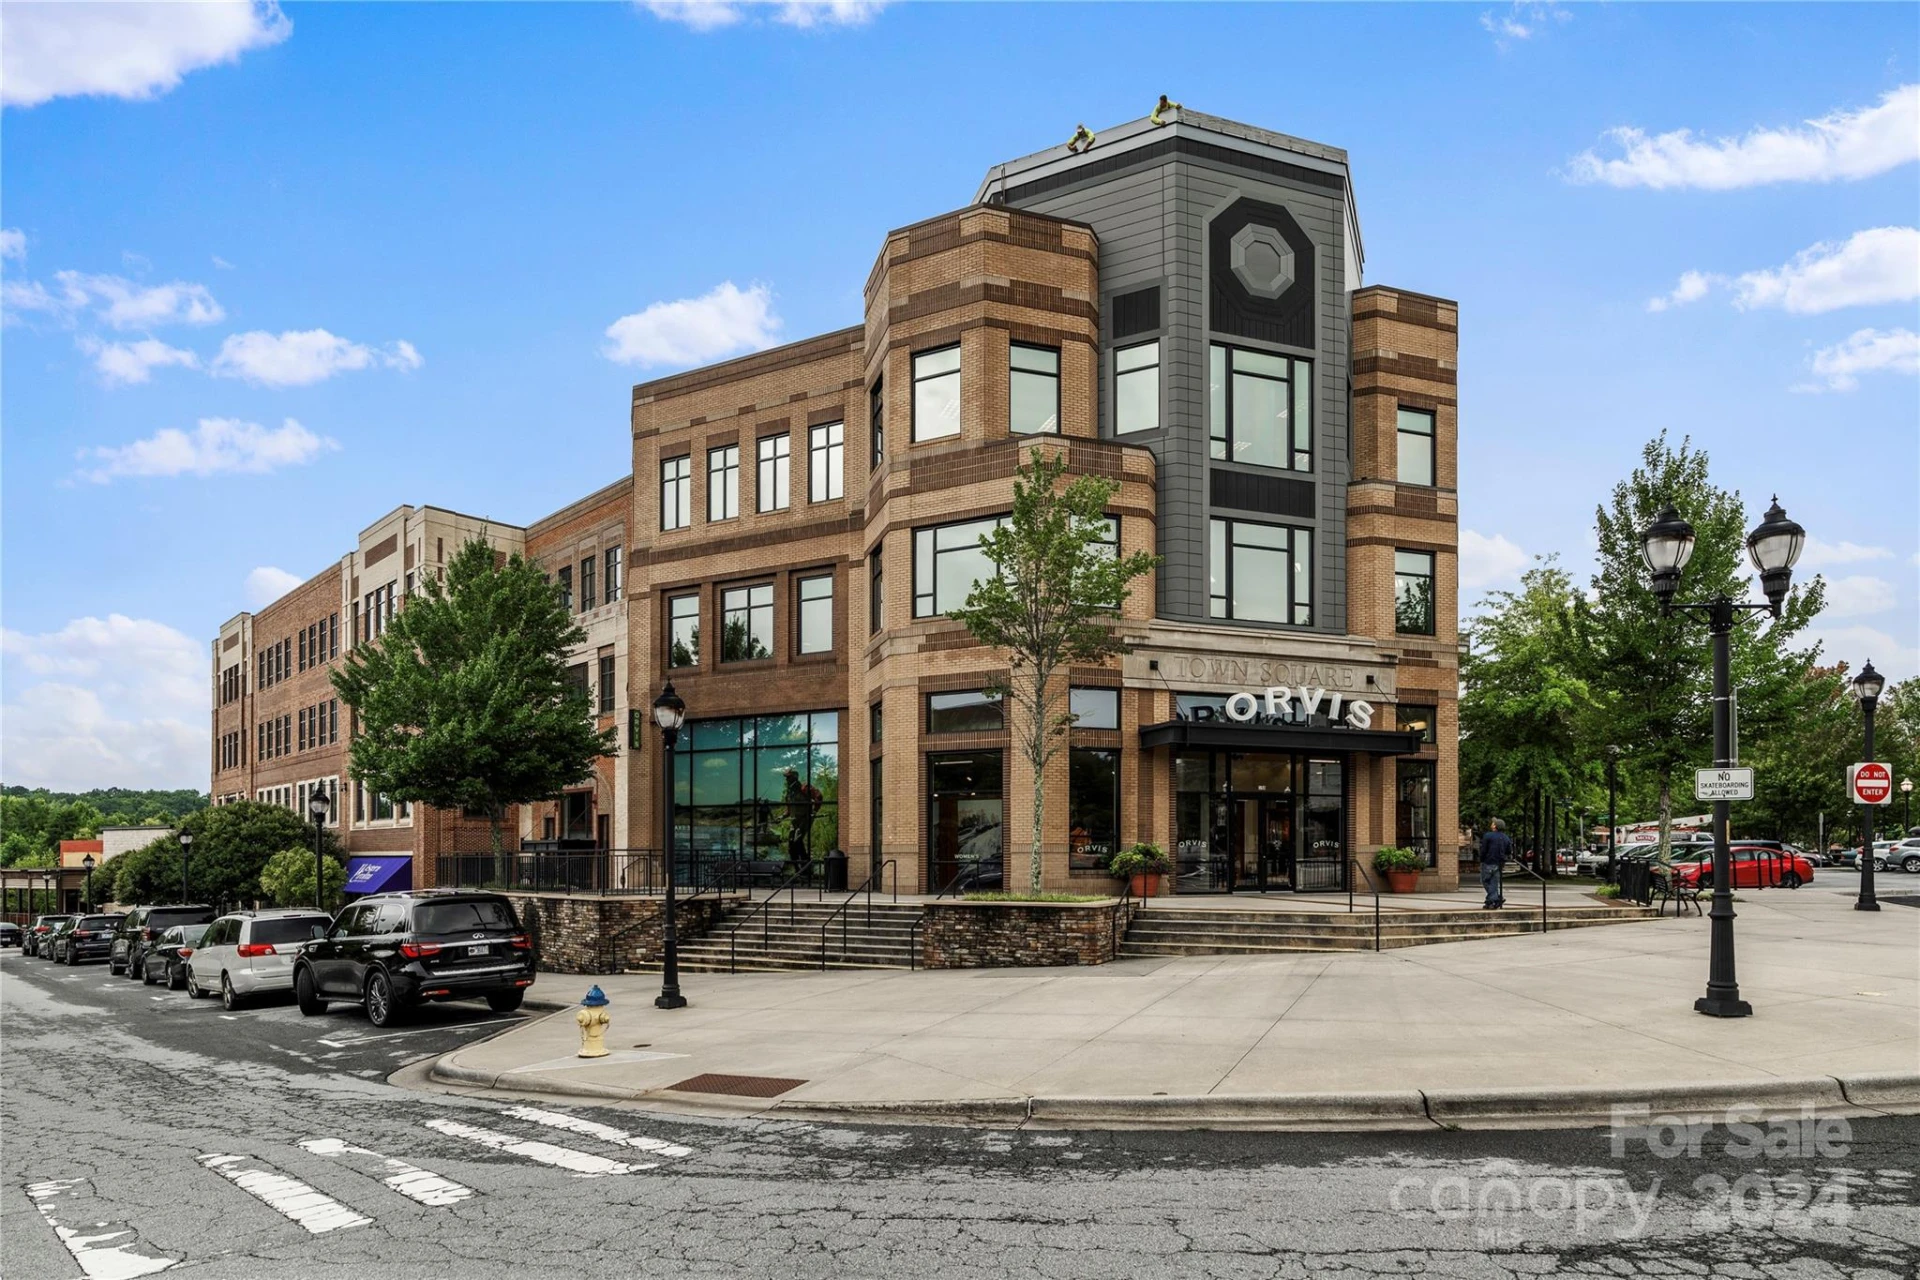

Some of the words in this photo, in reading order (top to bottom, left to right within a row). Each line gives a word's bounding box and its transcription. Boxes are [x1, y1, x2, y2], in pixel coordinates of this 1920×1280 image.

[1173, 655, 1249, 682] TOWN
[1260, 662, 1354, 688] SQUARE
[1225, 686, 1375, 729] ORVIS
[1717, 772, 1731, 781] NO
[1862, 788, 1884, 796] ENTER
[1178, 839, 1208, 848] ORVIS
[1312, 839, 1340, 849] ORVIS
[1077, 845, 1108, 853] ORVIS
